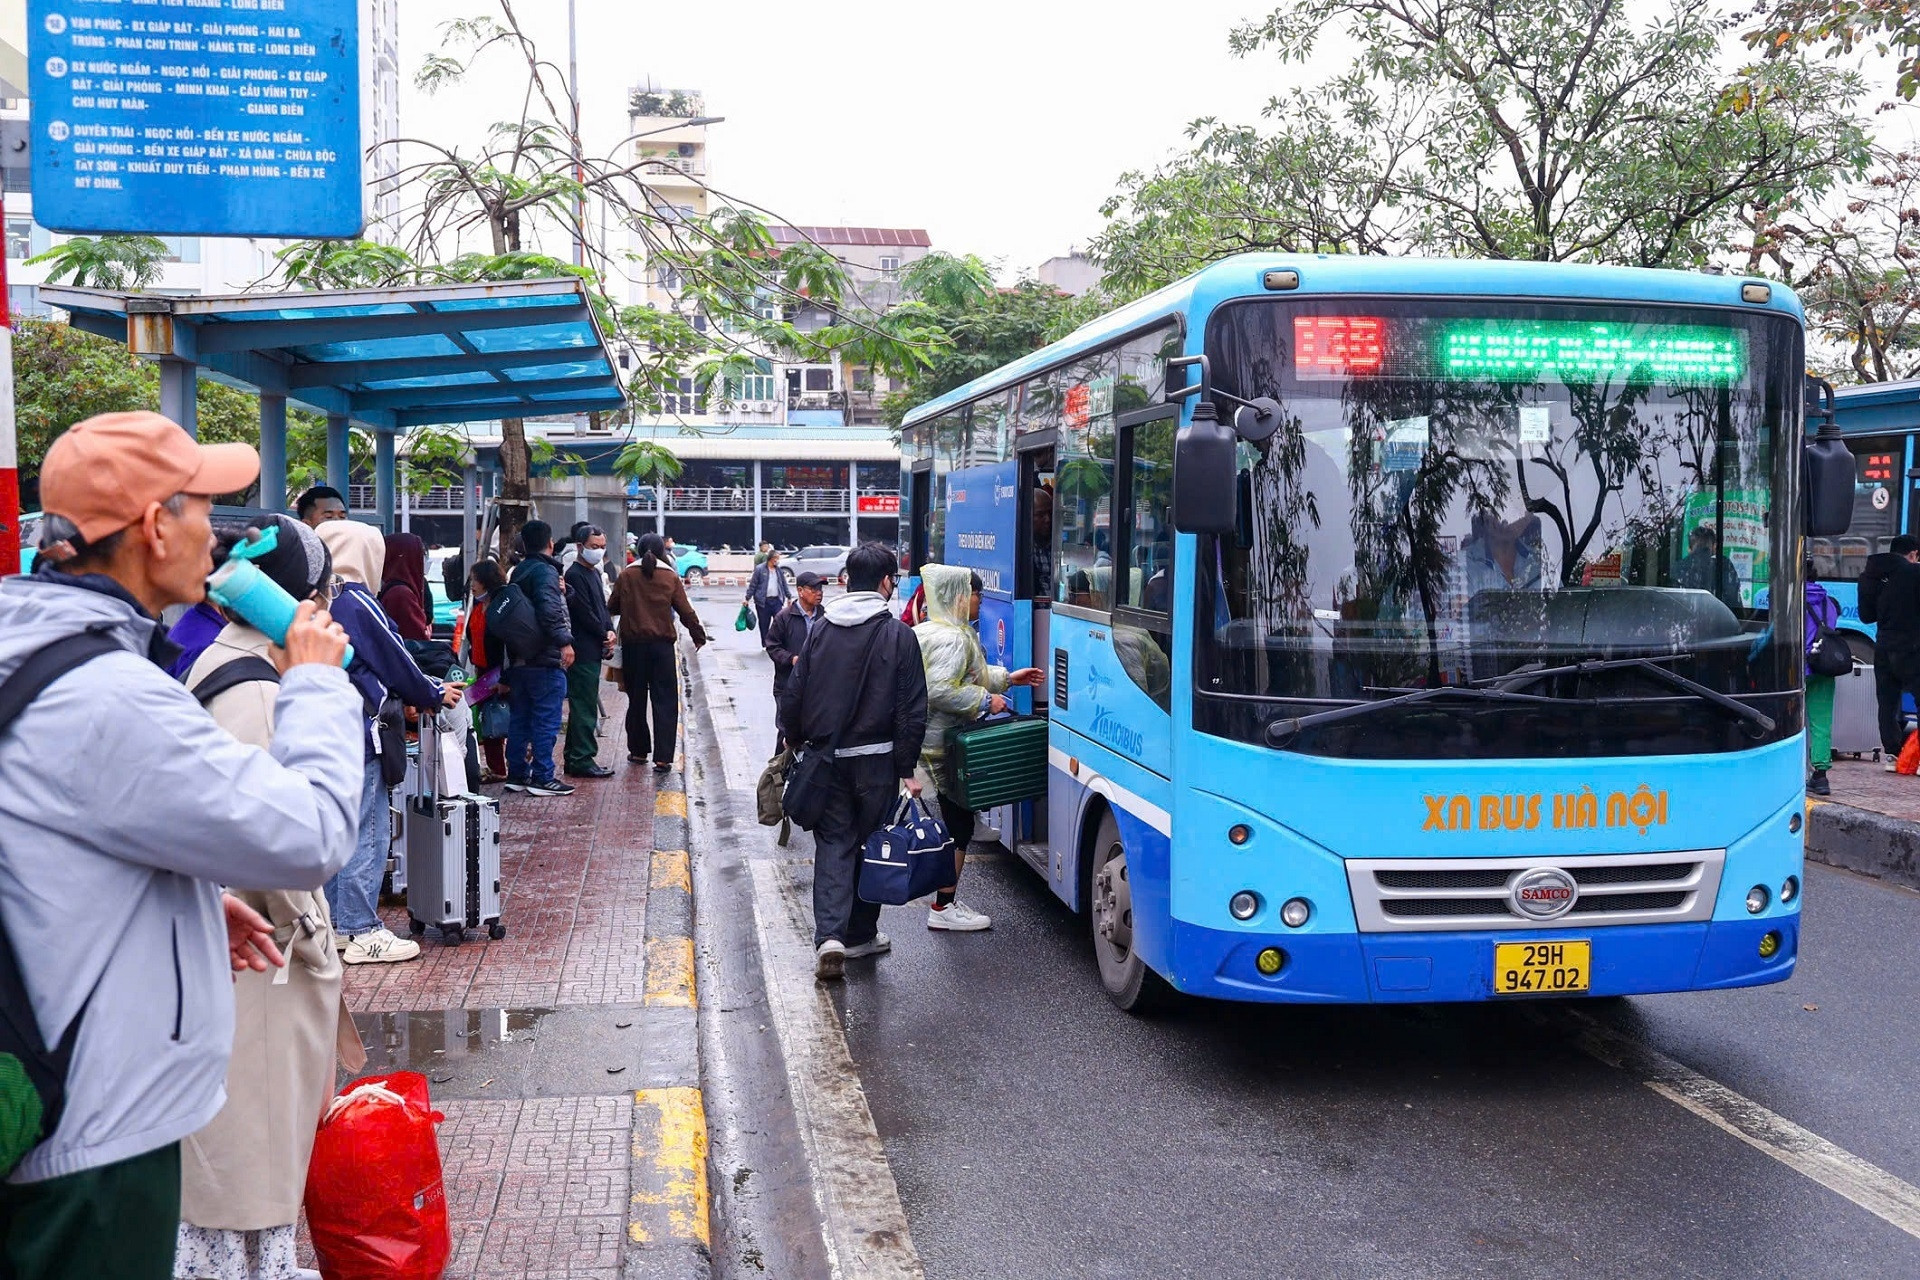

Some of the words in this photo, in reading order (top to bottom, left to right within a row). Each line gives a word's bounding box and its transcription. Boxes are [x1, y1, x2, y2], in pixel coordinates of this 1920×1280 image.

[268, 27, 285, 37] HAI
[287, 27, 300, 38] BA
[115, 37, 142, 48] PHAN
[145, 39, 166, 50] CHU
[169, 40, 198, 51] TRINH
[238, 43, 257, 53] TRE
[265, 44, 290, 55] LONG
[176, 84, 203, 94] MINH
[206, 85, 229, 96] KHAI
[290, 88, 308, 98] TUY
[72, 96, 95, 108] CHU
[97, 98, 118, 108] HUY
[247, 103, 279, 115] GIANG
[227, 131, 239, 142] XE
[167, 146, 179, 156] XE
[164, 163, 184, 173] DUY
[312, 168, 325, 178] XE
[1478, 794, 1543, 830] BUS
[1553, 784, 1597, 829] HÀ
[1606, 784, 1667, 836] NỘI
[1522, 889, 1570, 900] SAMCO
[1523, 946, 1563, 966] 29H
[1506, 968, 1580, 990] 947.02
